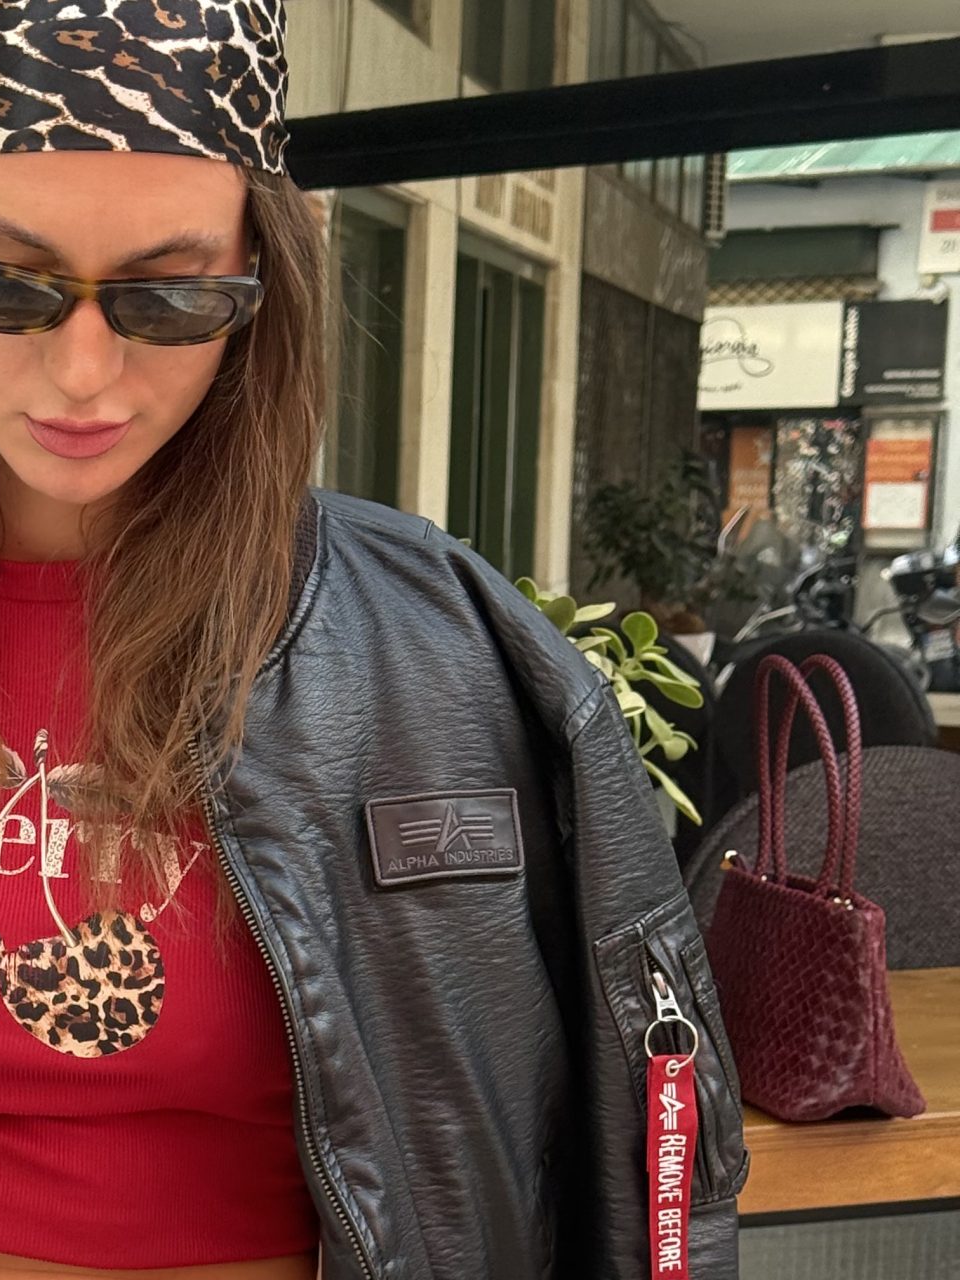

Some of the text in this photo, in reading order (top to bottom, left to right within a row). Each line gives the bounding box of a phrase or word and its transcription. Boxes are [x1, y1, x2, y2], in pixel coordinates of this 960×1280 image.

[387, 848, 514, 873] ALPHA INDUSTRIES
[657, 1133, 688, 1204] REMOVE
[657, 1207, 682, 1273] BEFORE
